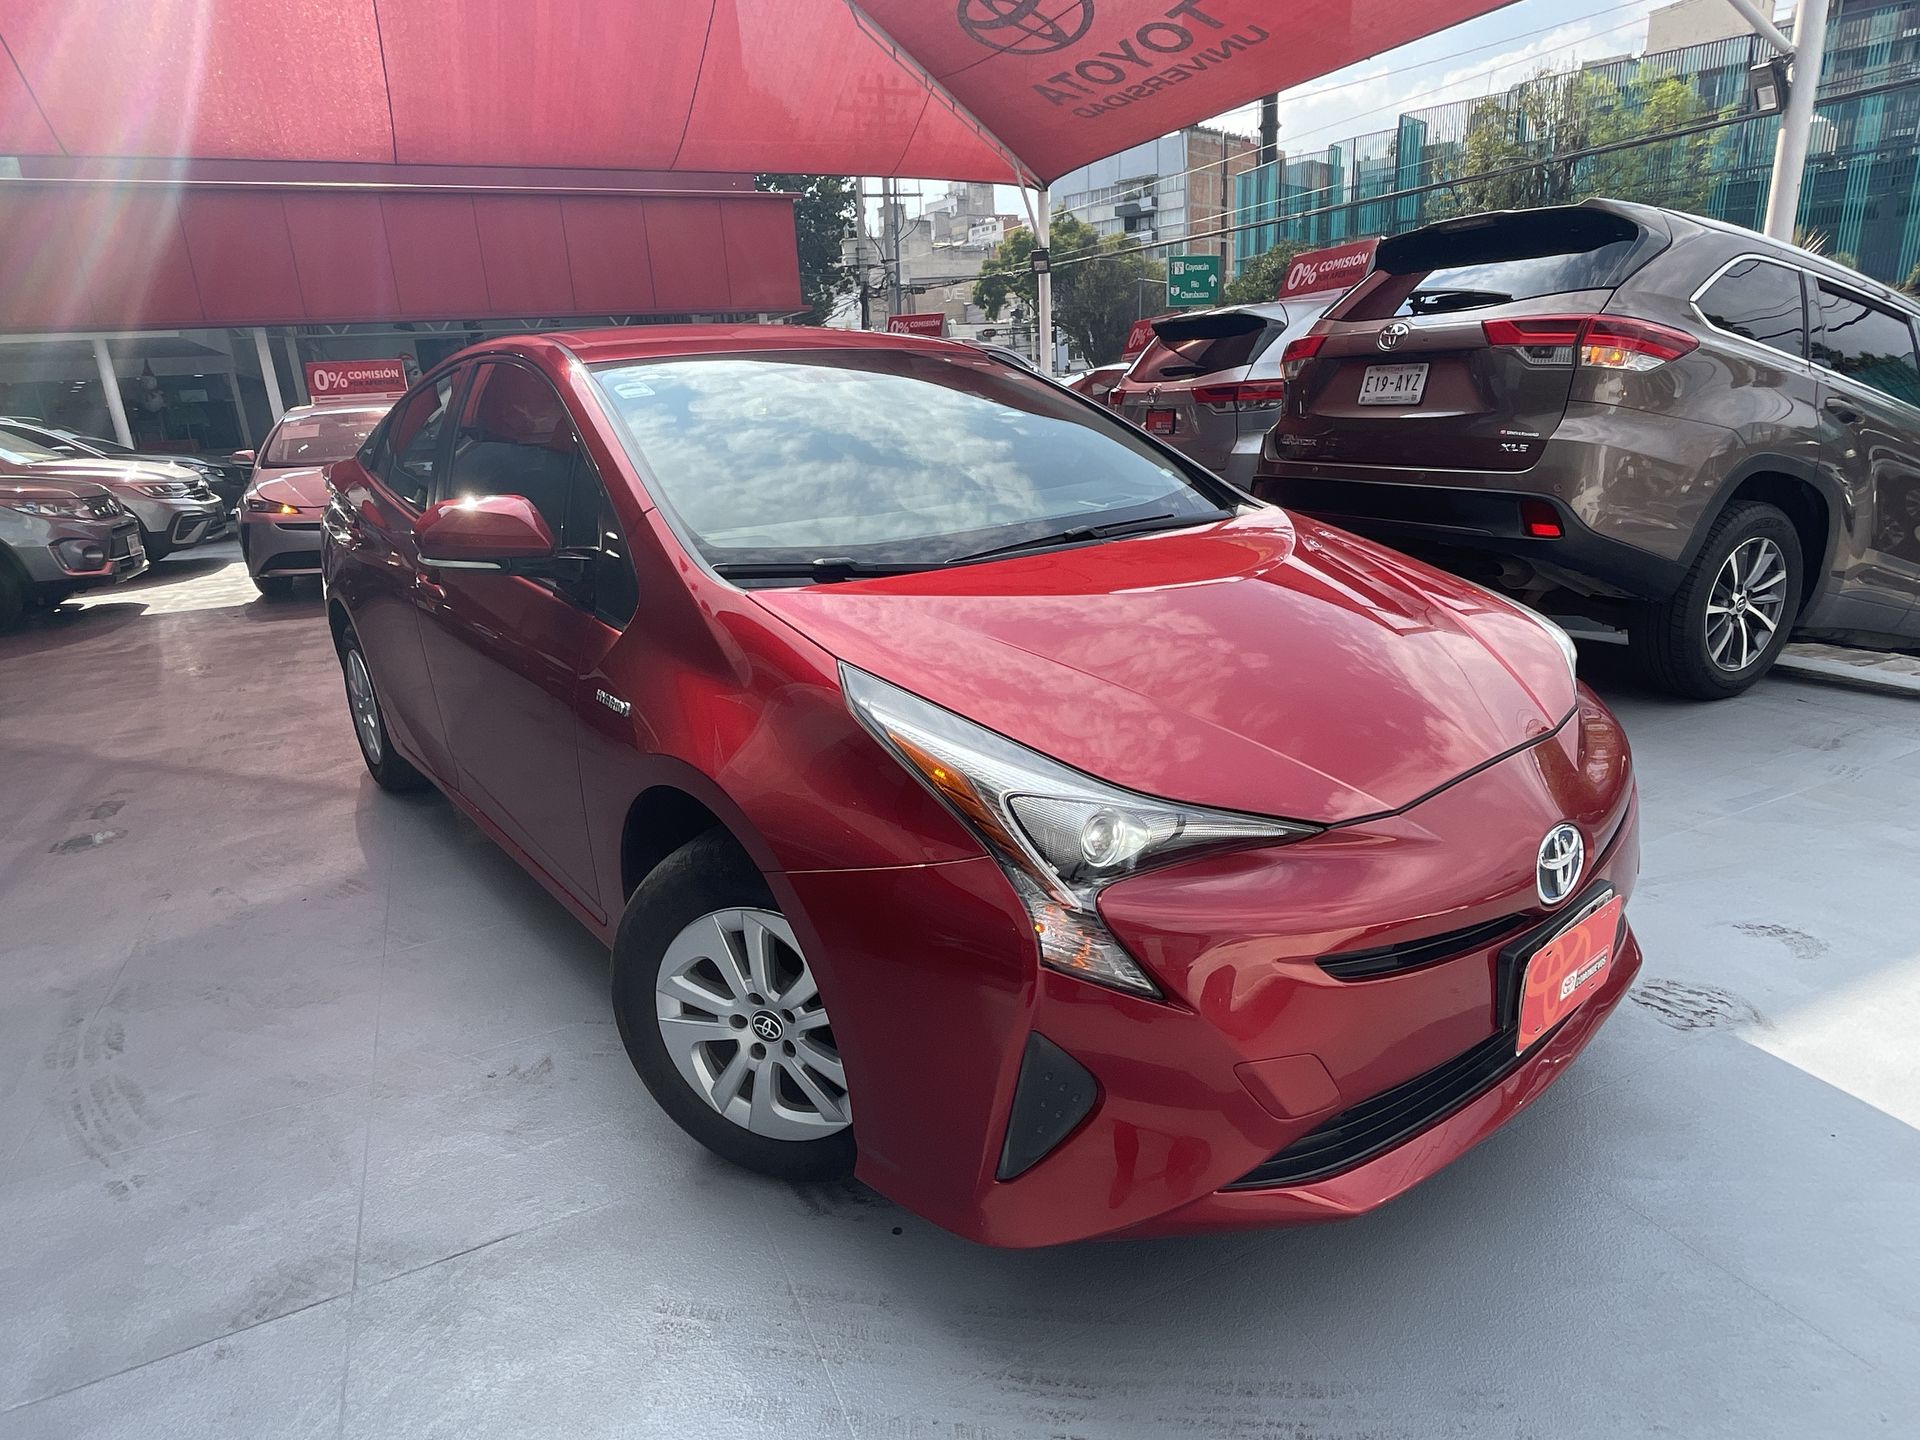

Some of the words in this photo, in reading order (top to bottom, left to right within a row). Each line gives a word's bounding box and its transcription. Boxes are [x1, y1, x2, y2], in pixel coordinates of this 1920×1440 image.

[1287, 262, 1318, 291] 0%
[1319, 251, 1370, 273] COMISIÓN
[910, 318, 941, 328] COMISIÓN
[314, 369, 348, 391] 0%
[347, 367, 400, 380] COMISIÓN
[1364, 373, 1422, 393] E19-AYZ
